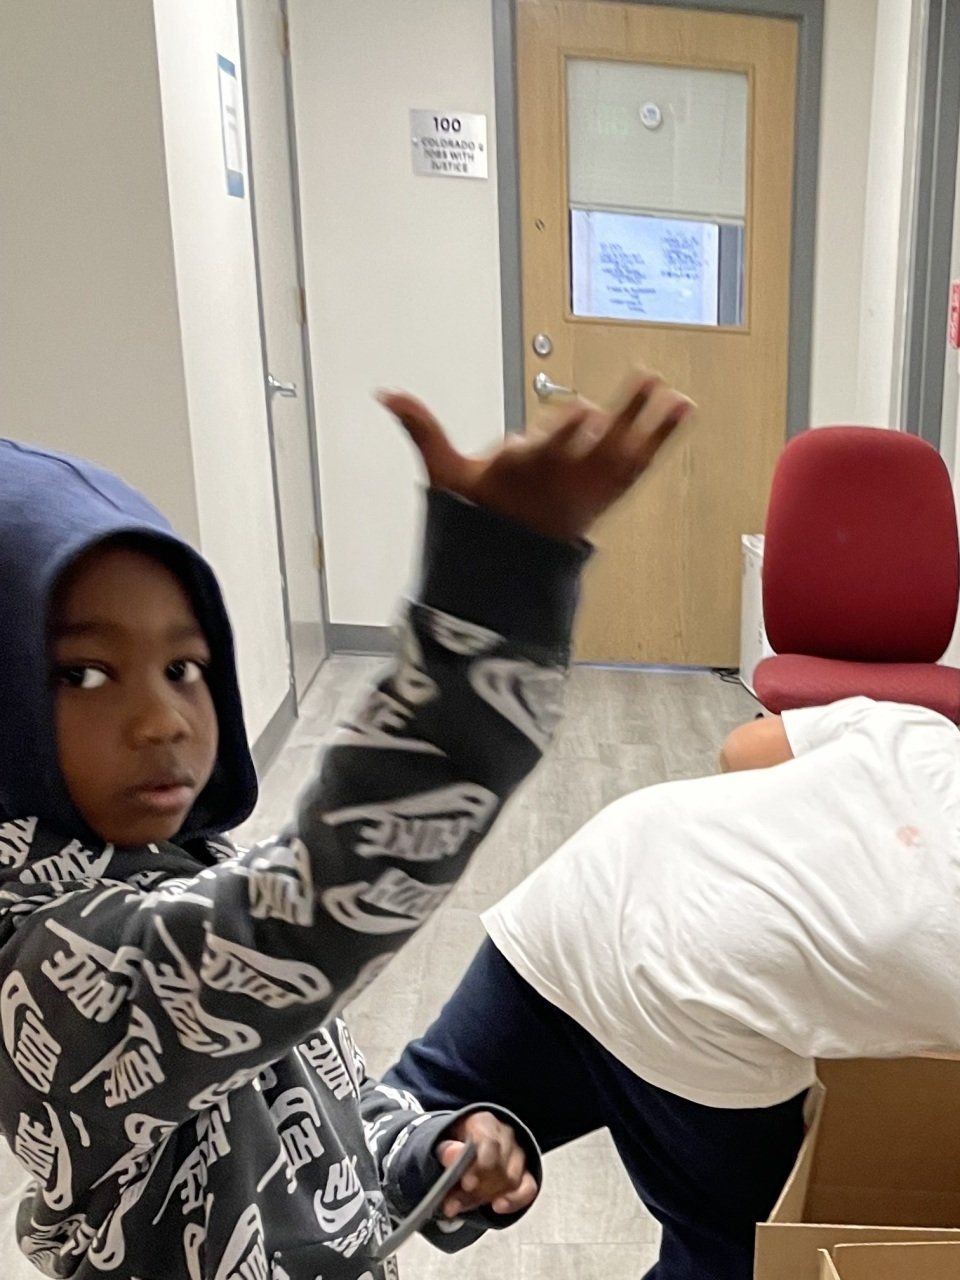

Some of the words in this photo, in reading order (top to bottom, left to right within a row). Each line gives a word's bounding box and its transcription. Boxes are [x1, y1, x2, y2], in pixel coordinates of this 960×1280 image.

[421, 137, 475, 151] COLORADO
[433, 116, 461, 132] 100
[41, 950, 127, 1023] NIKE
[143, 959, 224, 1053] NIKE
[104, 1044, 165, 1108] NIKE
[298, 1038, 353, 1100] NIKE
